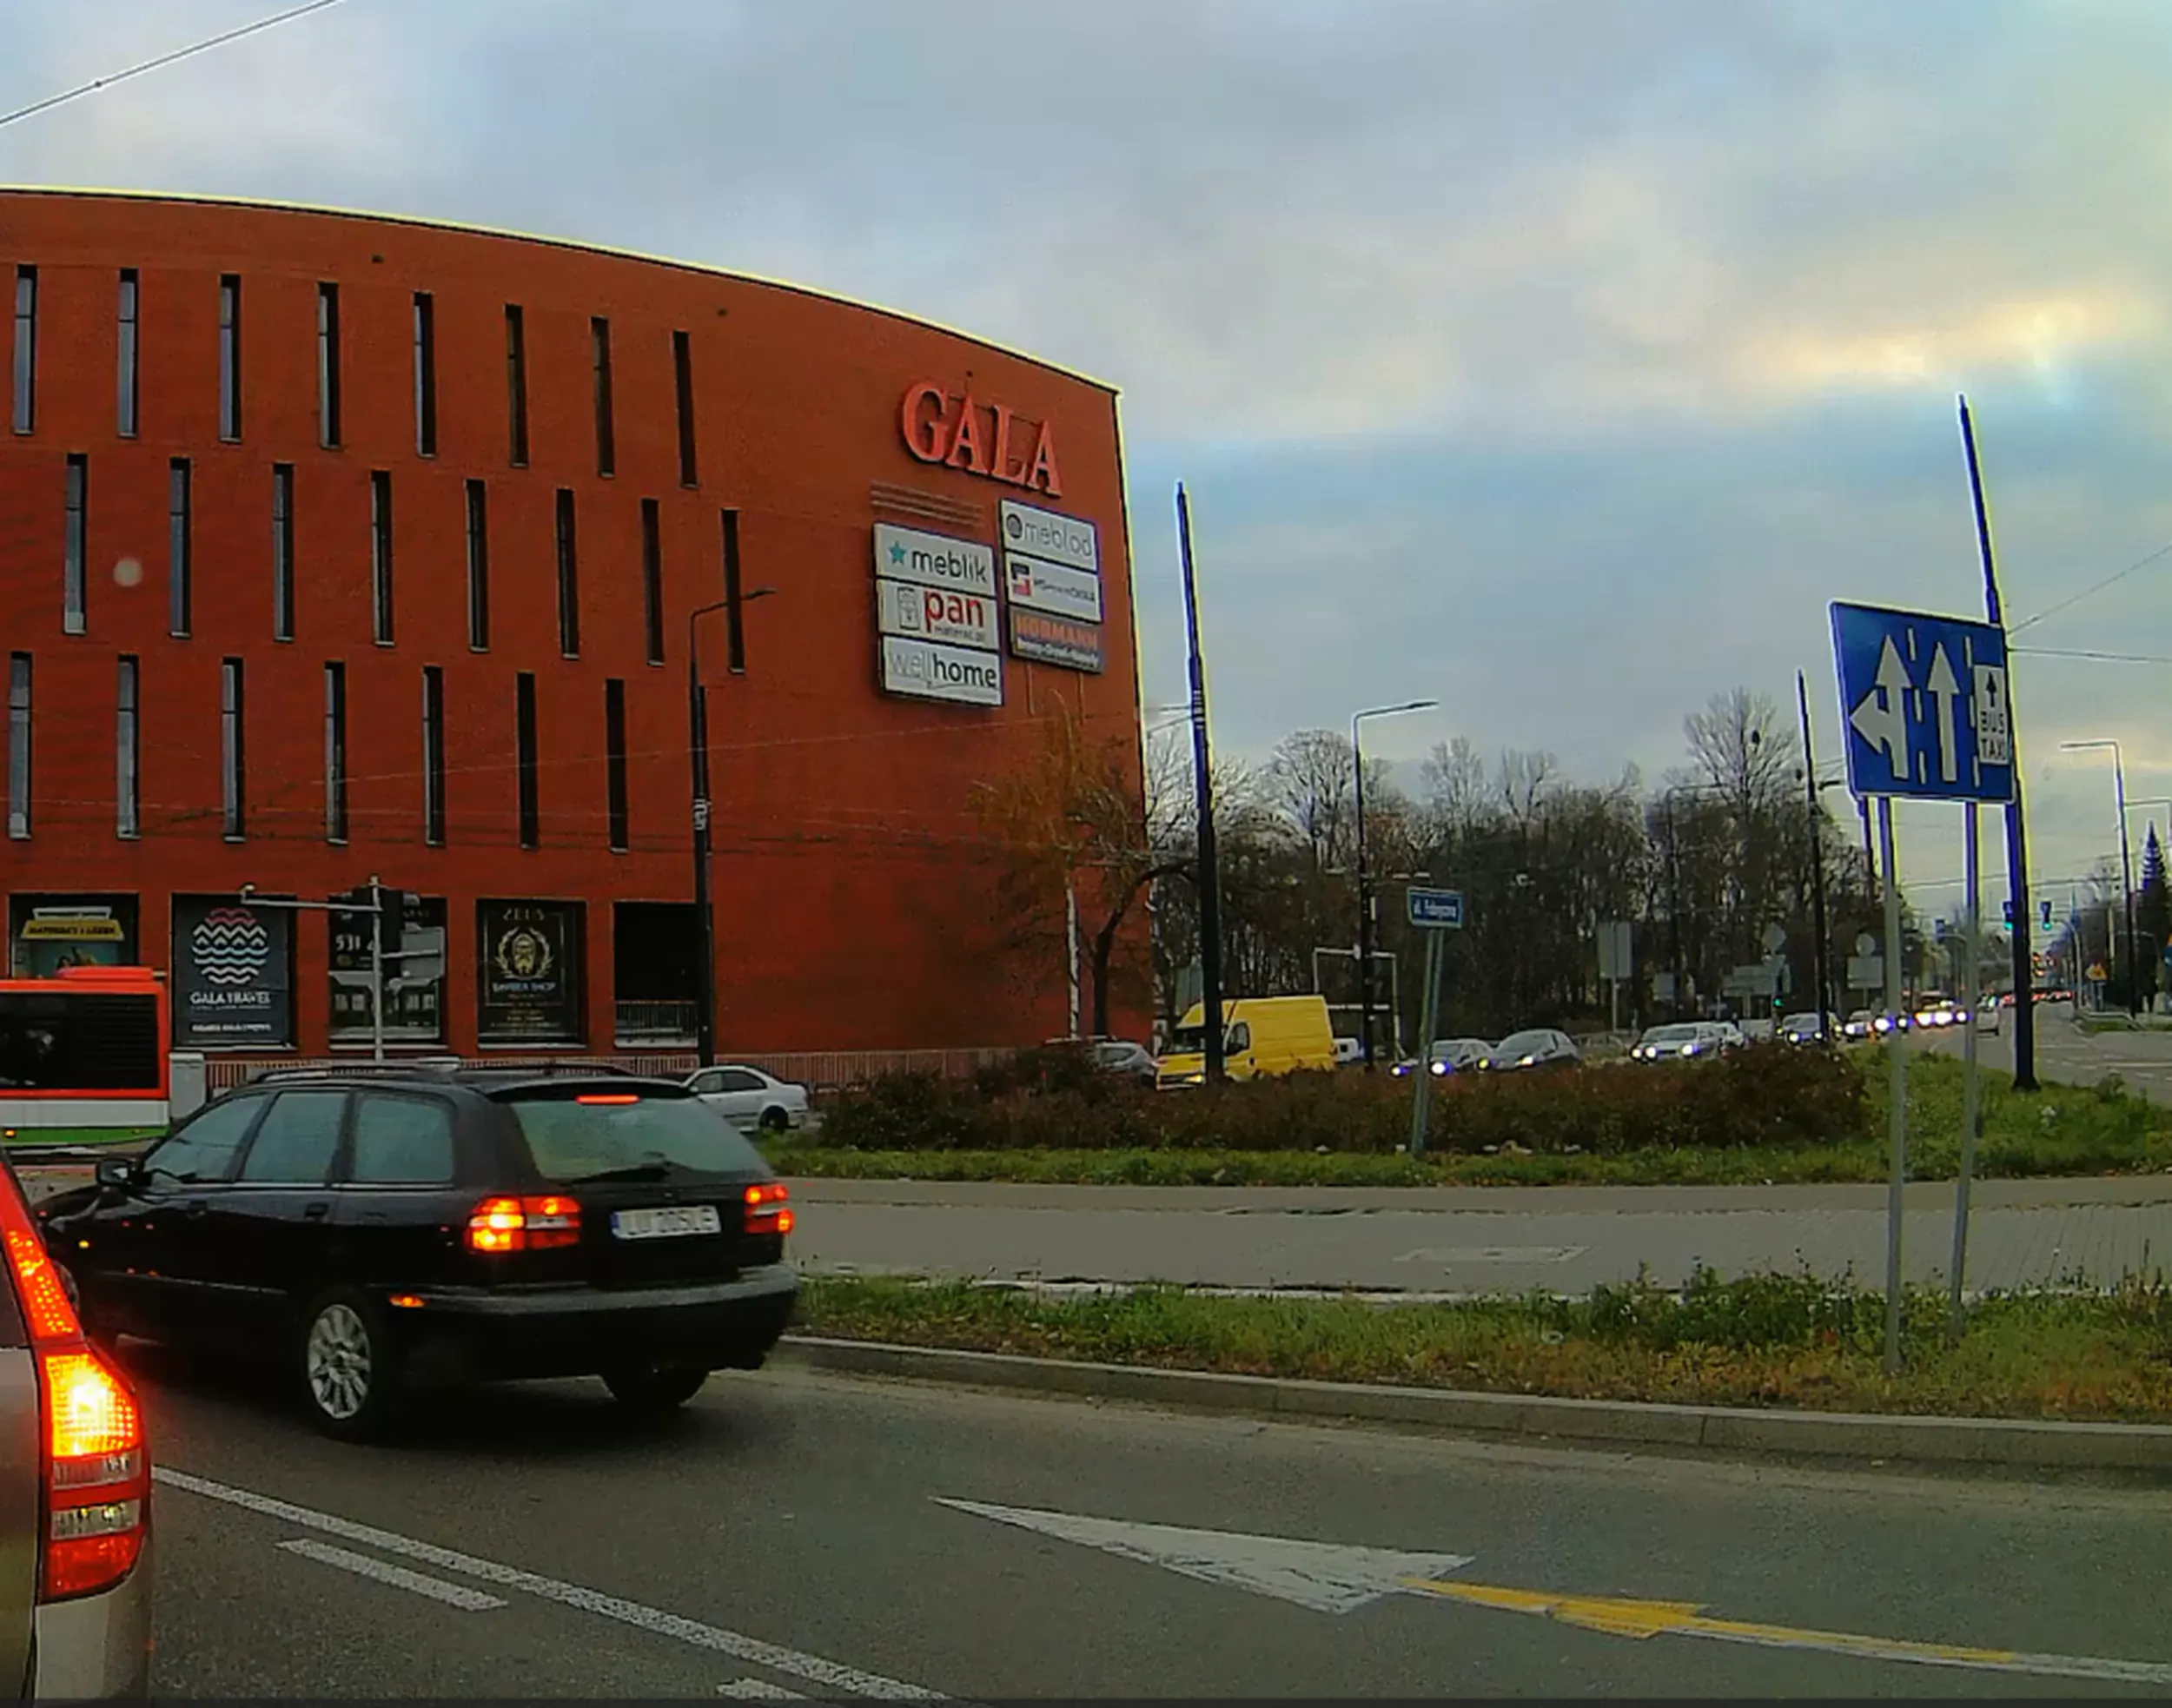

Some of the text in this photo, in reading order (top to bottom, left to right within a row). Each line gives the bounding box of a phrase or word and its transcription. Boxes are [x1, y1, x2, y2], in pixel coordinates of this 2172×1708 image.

[904, 383, 1062, 496] GALA
[911, 550, 987, 584] meblik
[924, 590, 984, 633] pan
[1981, 711, 2004, 734] BUS
